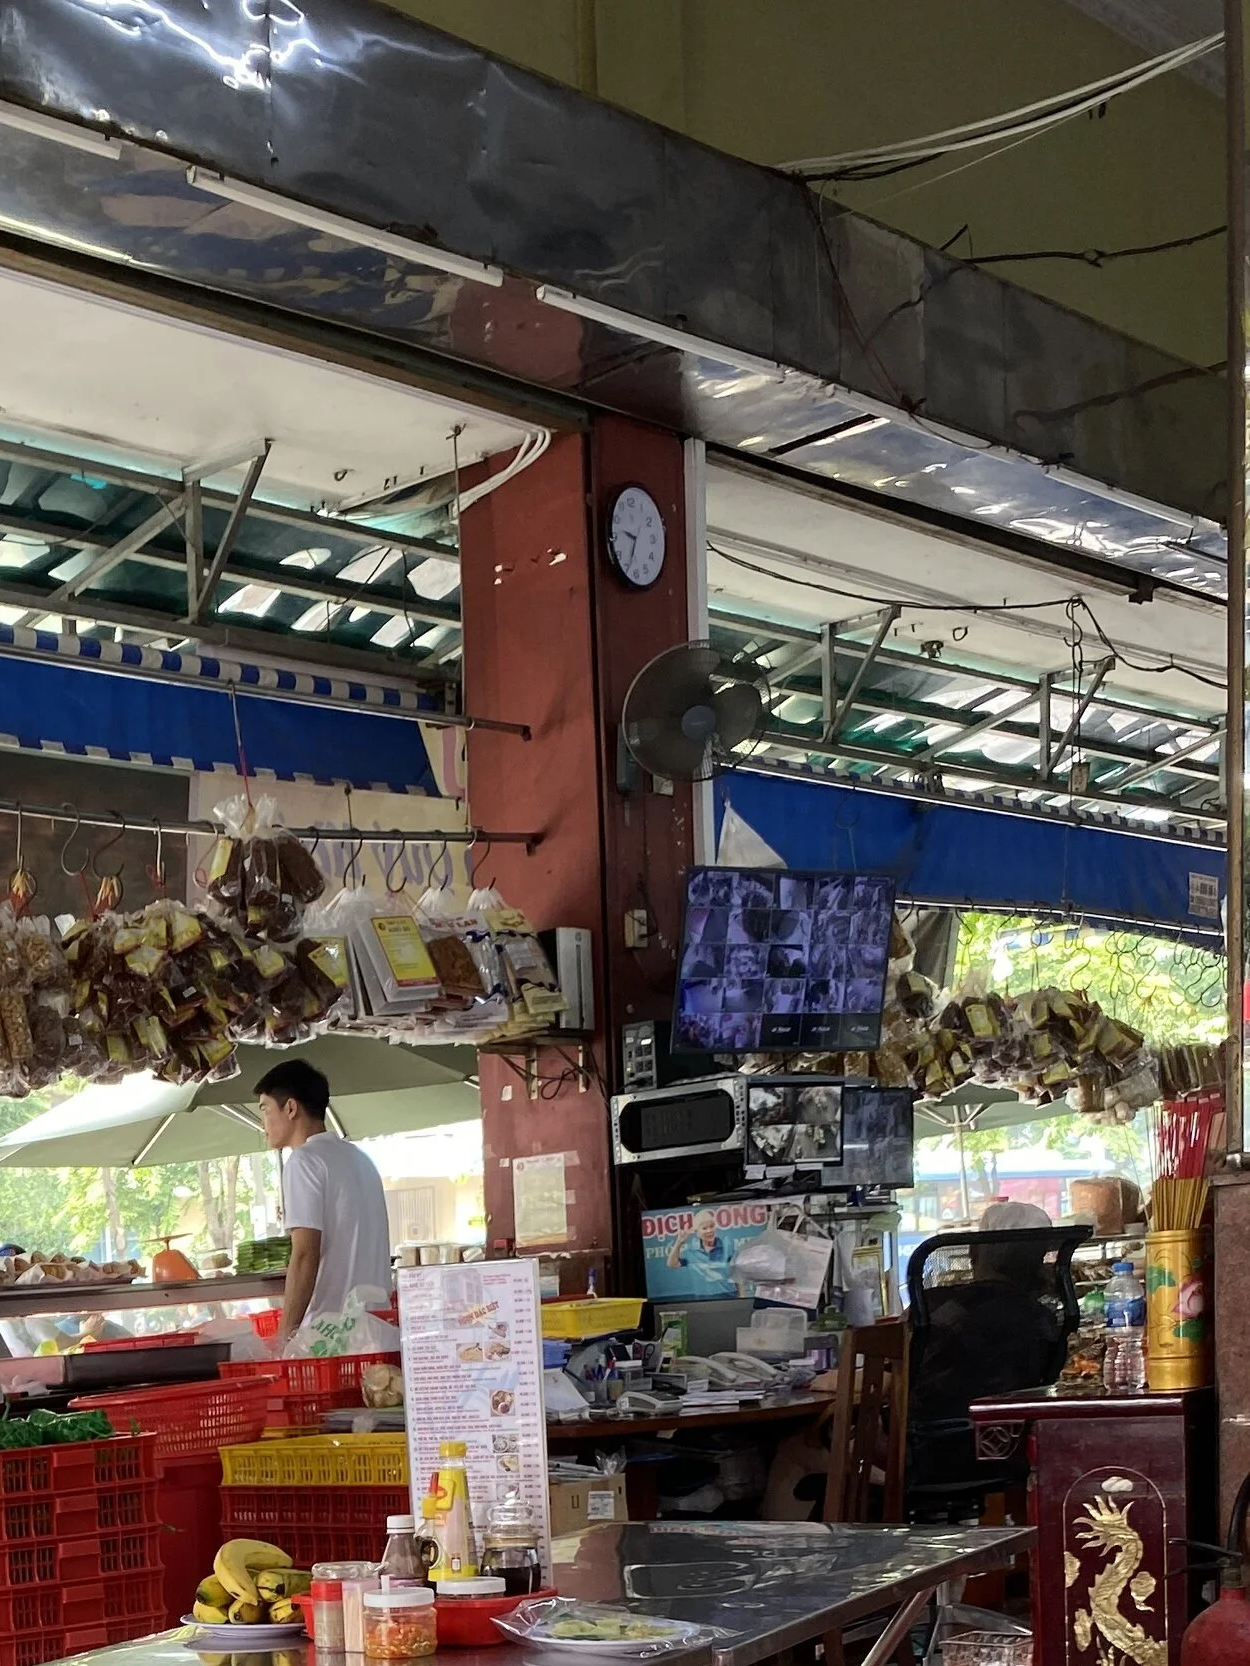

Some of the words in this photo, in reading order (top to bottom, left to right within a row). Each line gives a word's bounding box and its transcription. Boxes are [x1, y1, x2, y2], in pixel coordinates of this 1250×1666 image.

[626, 497, 636, 508] 12
[646, 517, 652, 528] 2
[650, 534, 656, 544] 3
[648, 552, 654, 562] 4
[633, 568, 640, 579] 6
[642, 564, 649, 574] 5
[642, 1213, 693, 1241] DỊCH
[707, 1205, 766, 1229] ONG
